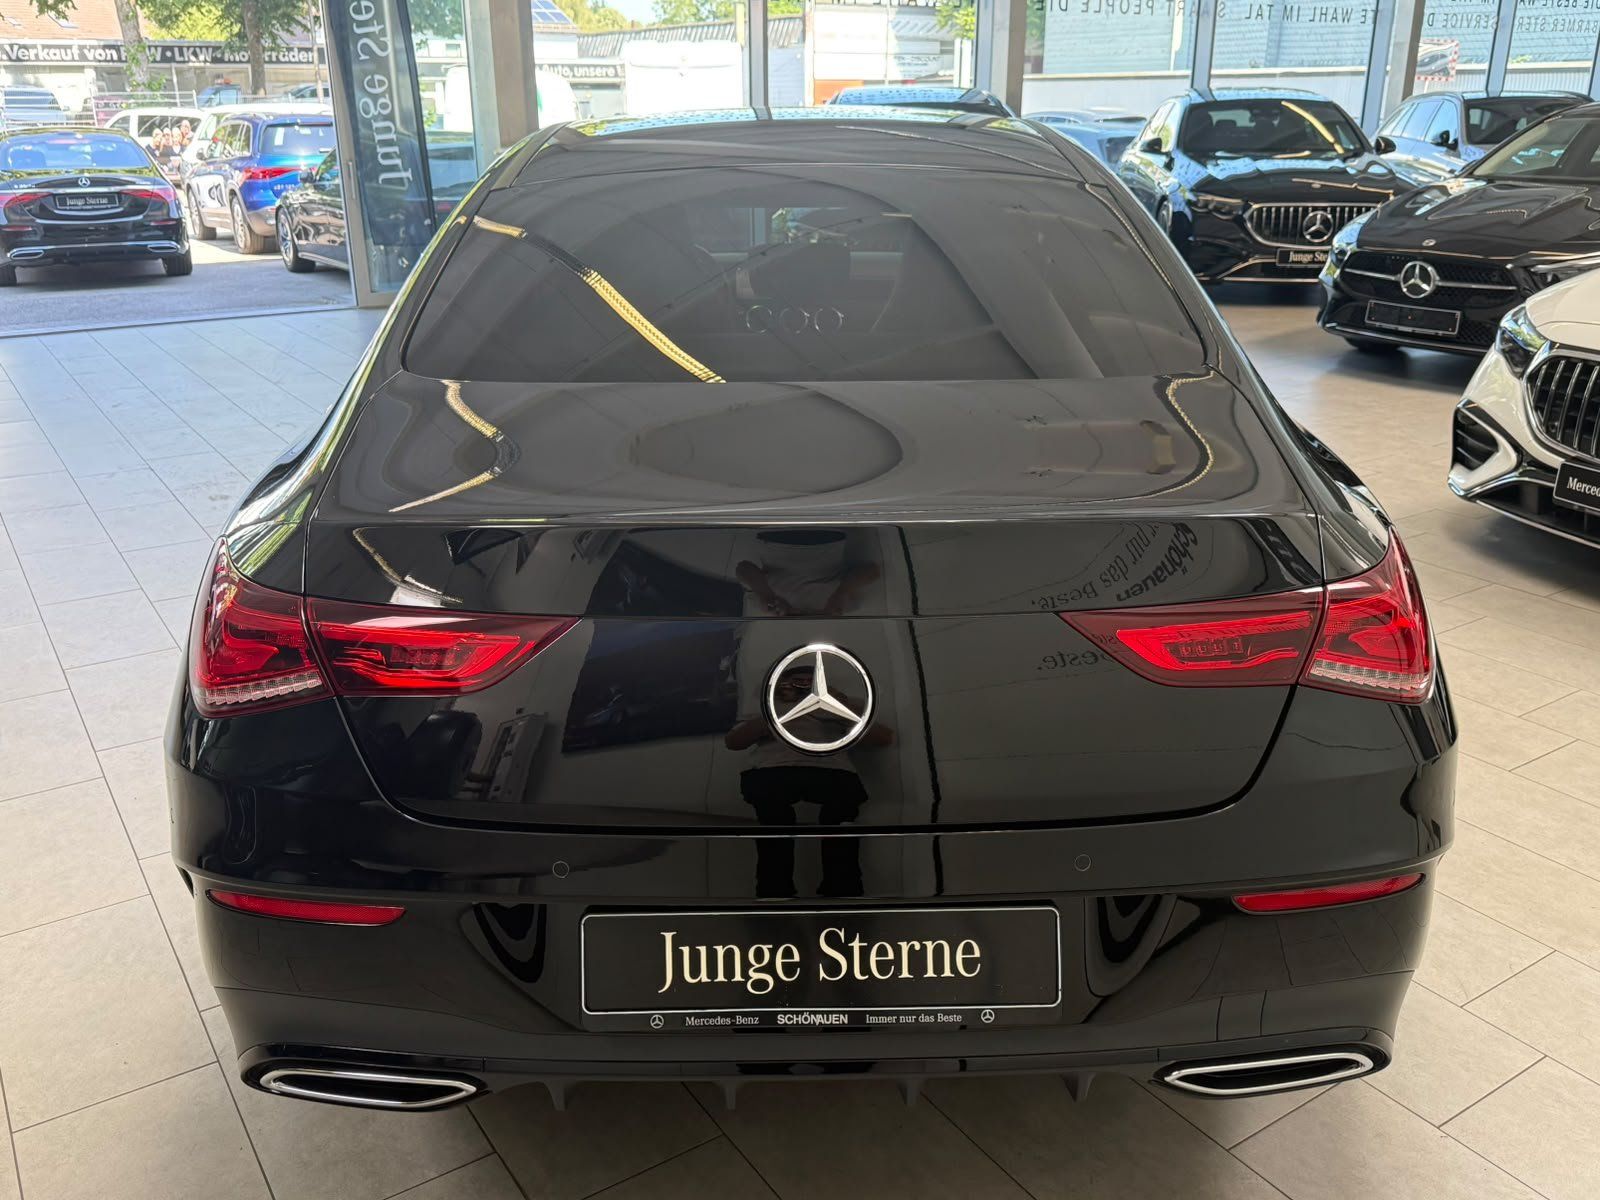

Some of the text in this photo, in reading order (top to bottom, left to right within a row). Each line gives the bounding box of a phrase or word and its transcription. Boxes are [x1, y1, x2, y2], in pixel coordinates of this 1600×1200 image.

[83, 47, 118, 61] von
[174, 47, 213, 62] LKW
[1289, 250, 1314, 264] Junge
[657, 927, 981, 995] Junge Sterne
[685, 1012, 963, 1026] Mercedes-Benz SCHÖNAUEN Immer nur das Beste
